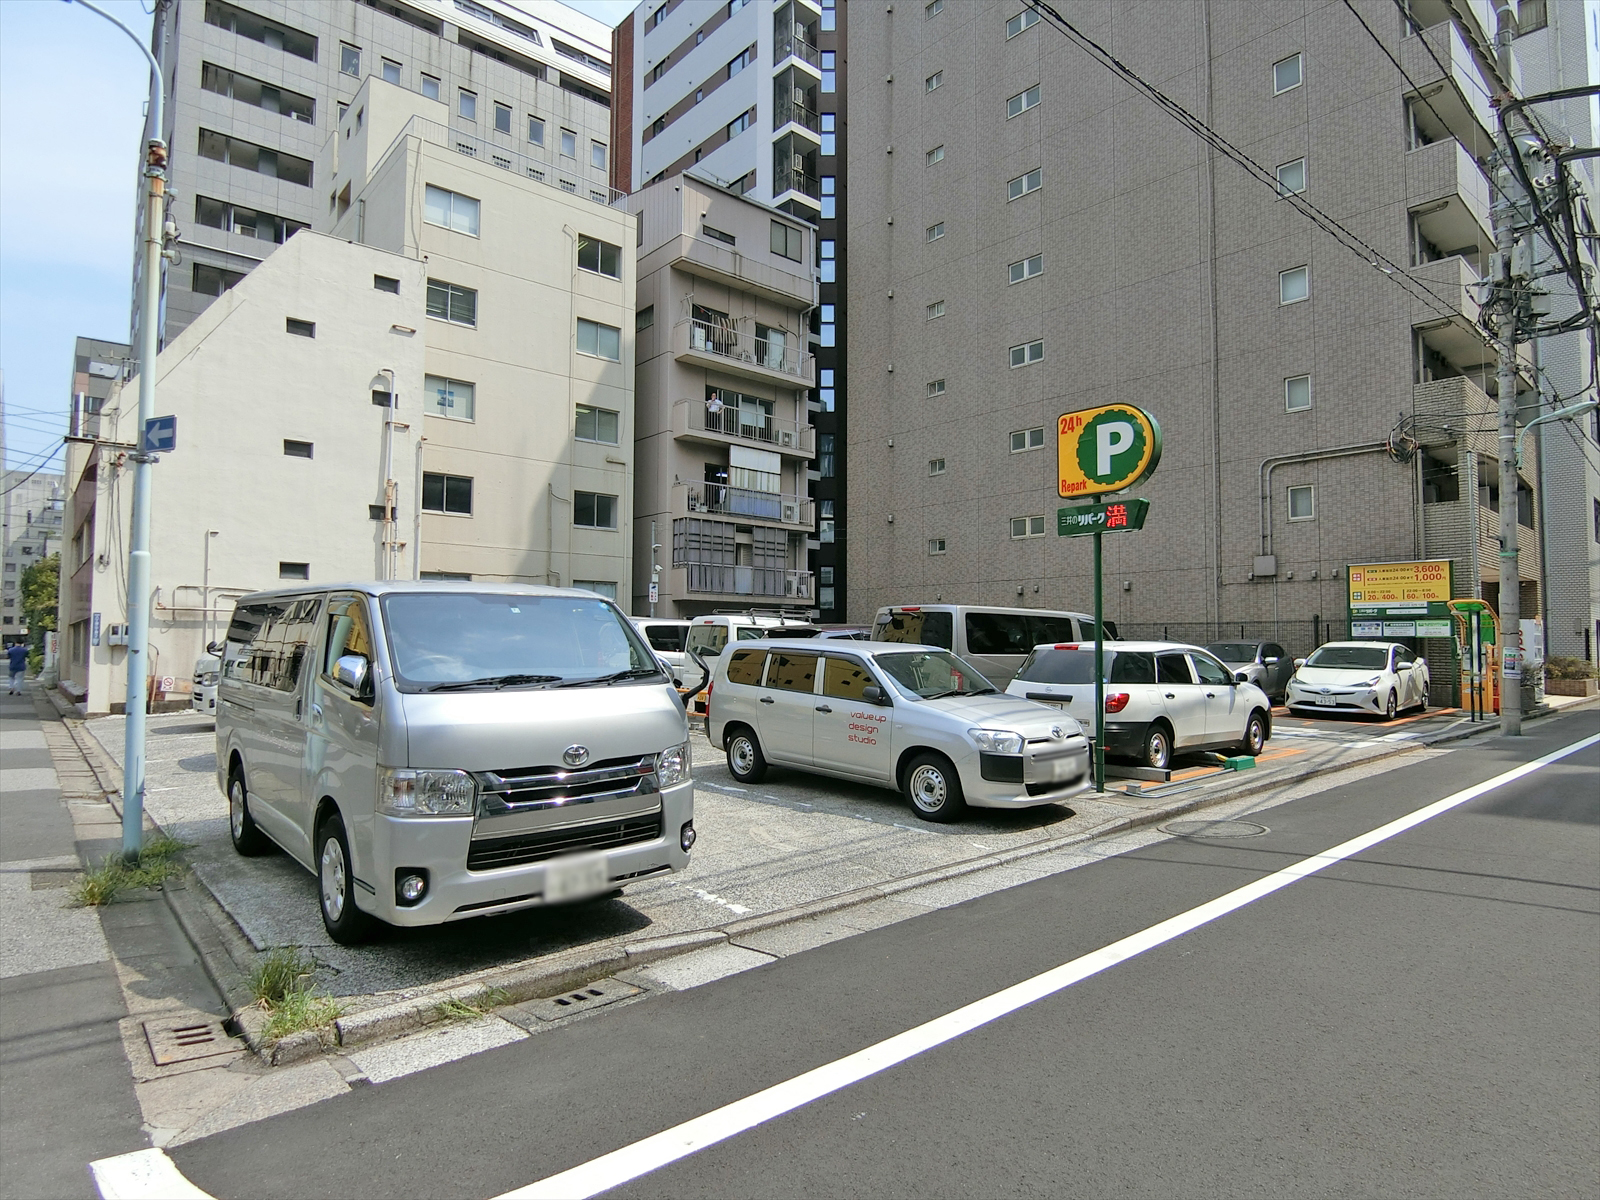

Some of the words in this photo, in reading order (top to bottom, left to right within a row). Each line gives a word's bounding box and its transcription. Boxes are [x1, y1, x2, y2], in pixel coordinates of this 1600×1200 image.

[1060, 416, 1082, 435] 24h
[1096, 421, 1135, 476] P
[1061, 479, 1087, 494] Repark
[1061, 512, 1106, 527] 三井のリパーク
[1106, 504, 1128, 528] 満
[850, 712, 874, 720] value
[874, 715, 887, 723] up
[848, 722, 878, 734] design
[848, 734, 876, 745] studio
